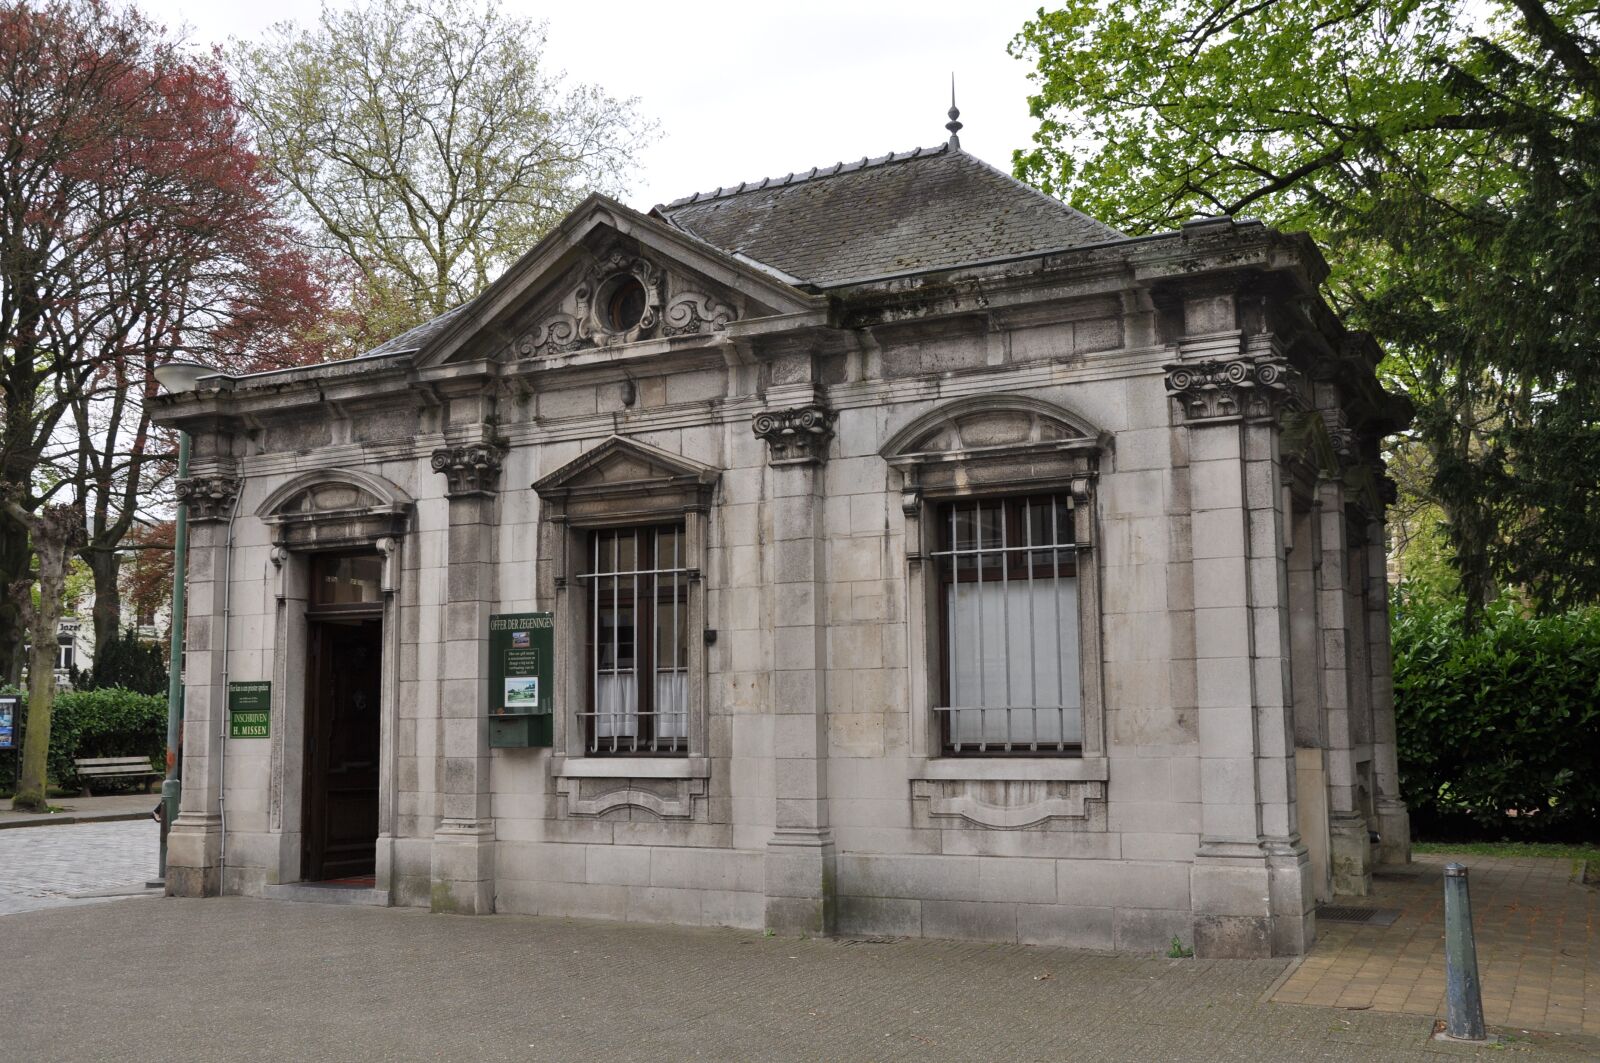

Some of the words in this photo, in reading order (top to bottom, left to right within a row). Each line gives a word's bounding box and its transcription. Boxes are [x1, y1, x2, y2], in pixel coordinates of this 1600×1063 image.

[490, 620, 506, 630] OFFER
[508, 619, 518, 630] DER
[520, 618, 554, 629] ZEGENINGEN
[234, 714, 266, 723] INSCHRIJVEN
[234, 726, 240, 734] H.
[242, 726, 266, 734] MISSEN
